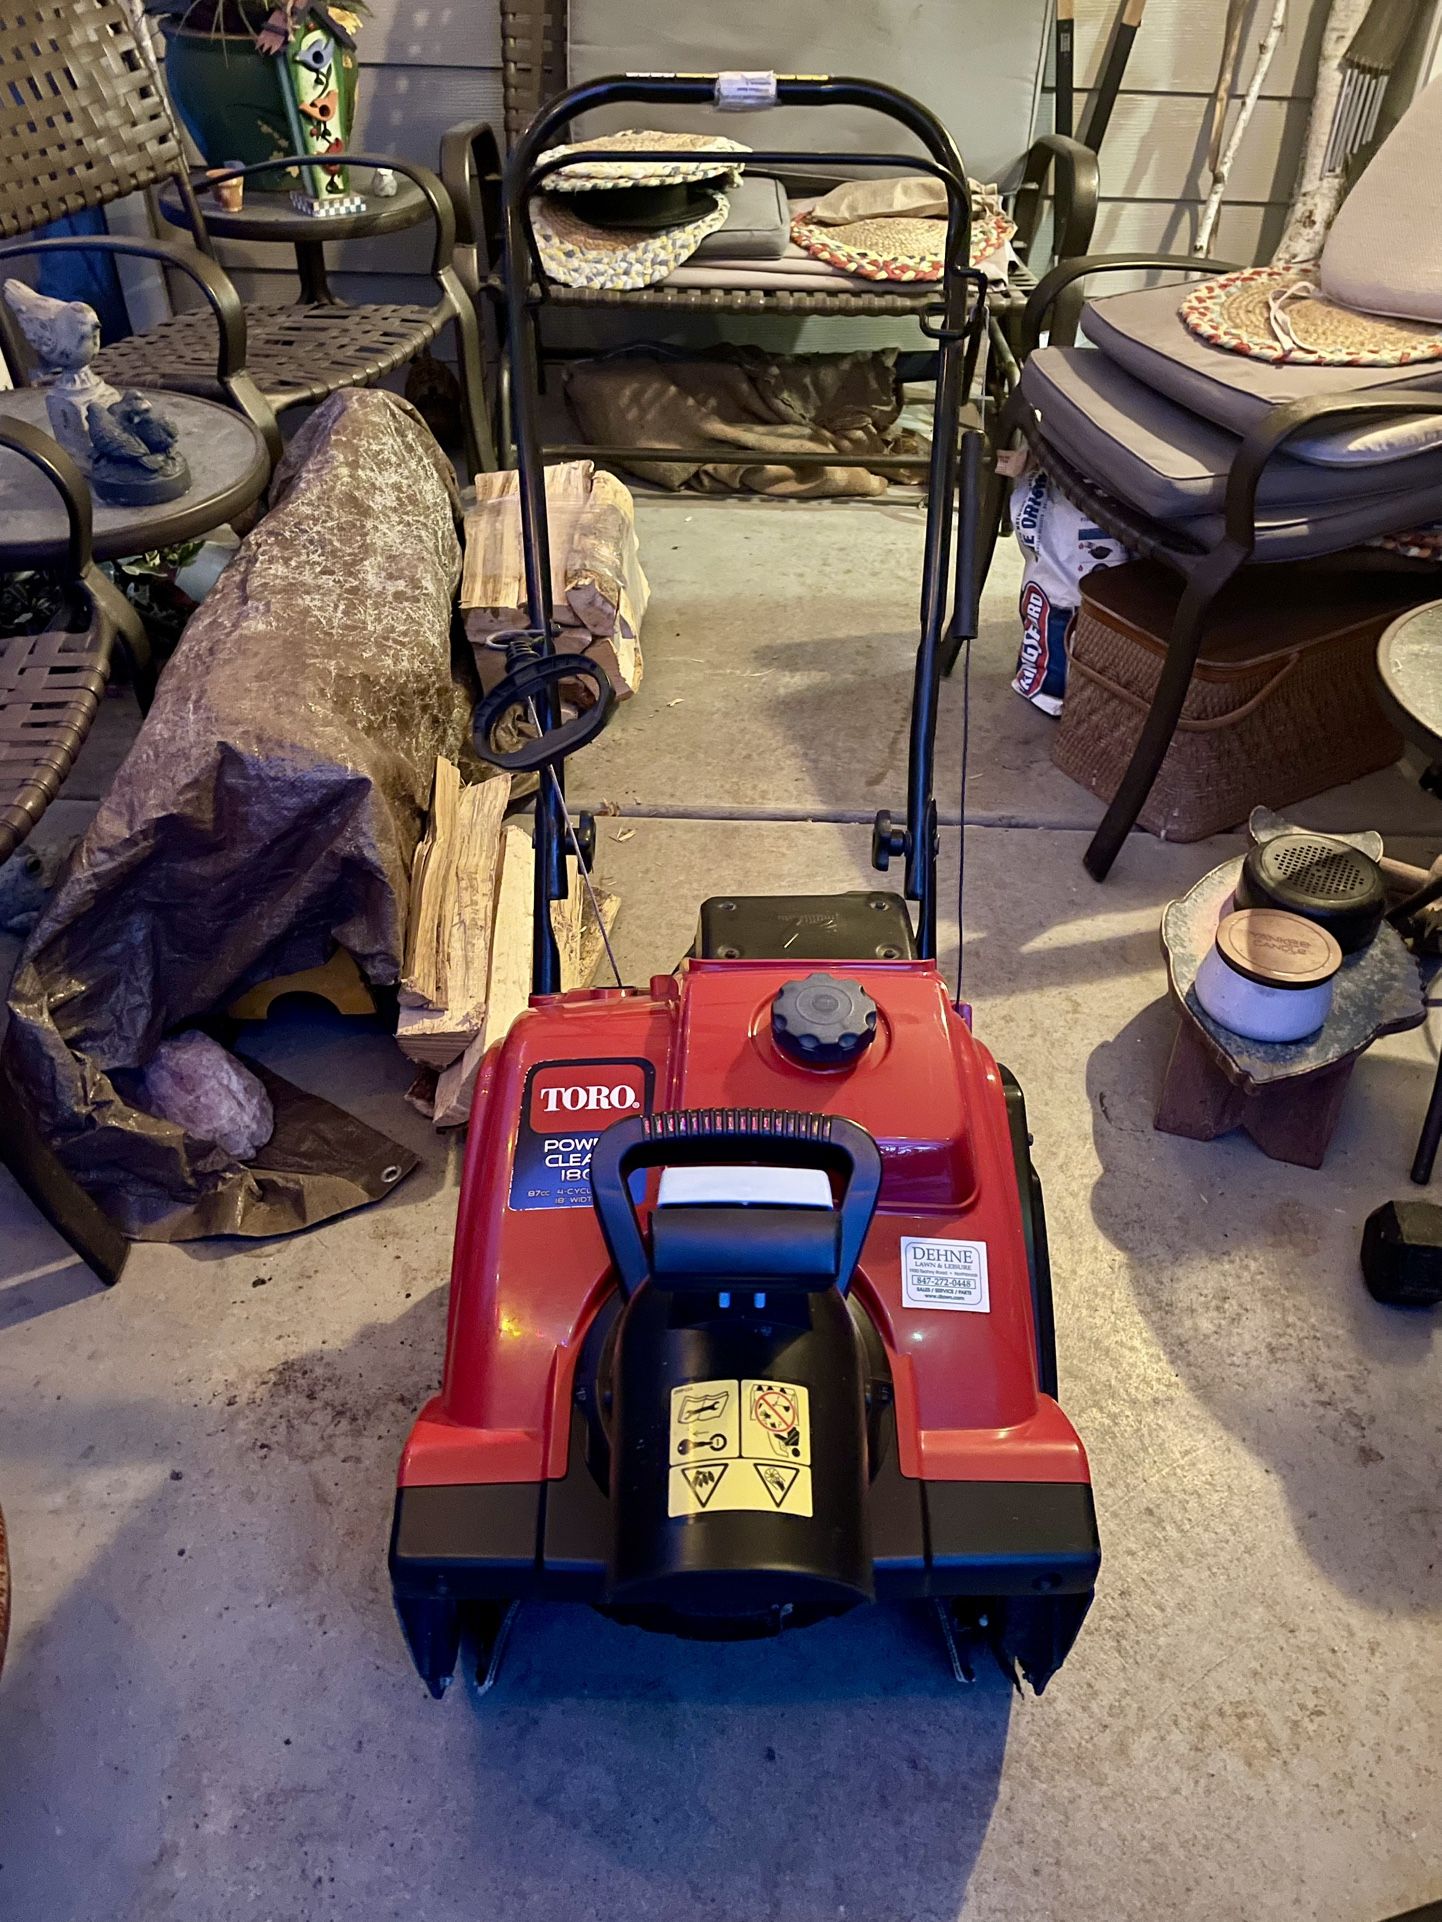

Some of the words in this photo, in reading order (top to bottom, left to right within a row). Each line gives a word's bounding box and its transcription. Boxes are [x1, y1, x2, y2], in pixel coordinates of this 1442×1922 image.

[1020, 593, 1043, 691] KINGSFRD
[544, 1137, 599, 1153] POW
[912, 1246, 973, 1263] DEHNE
[944, 1263, 972, 1271] LEISURE
[917, 1277, 971, 1287] 847-272-0448
